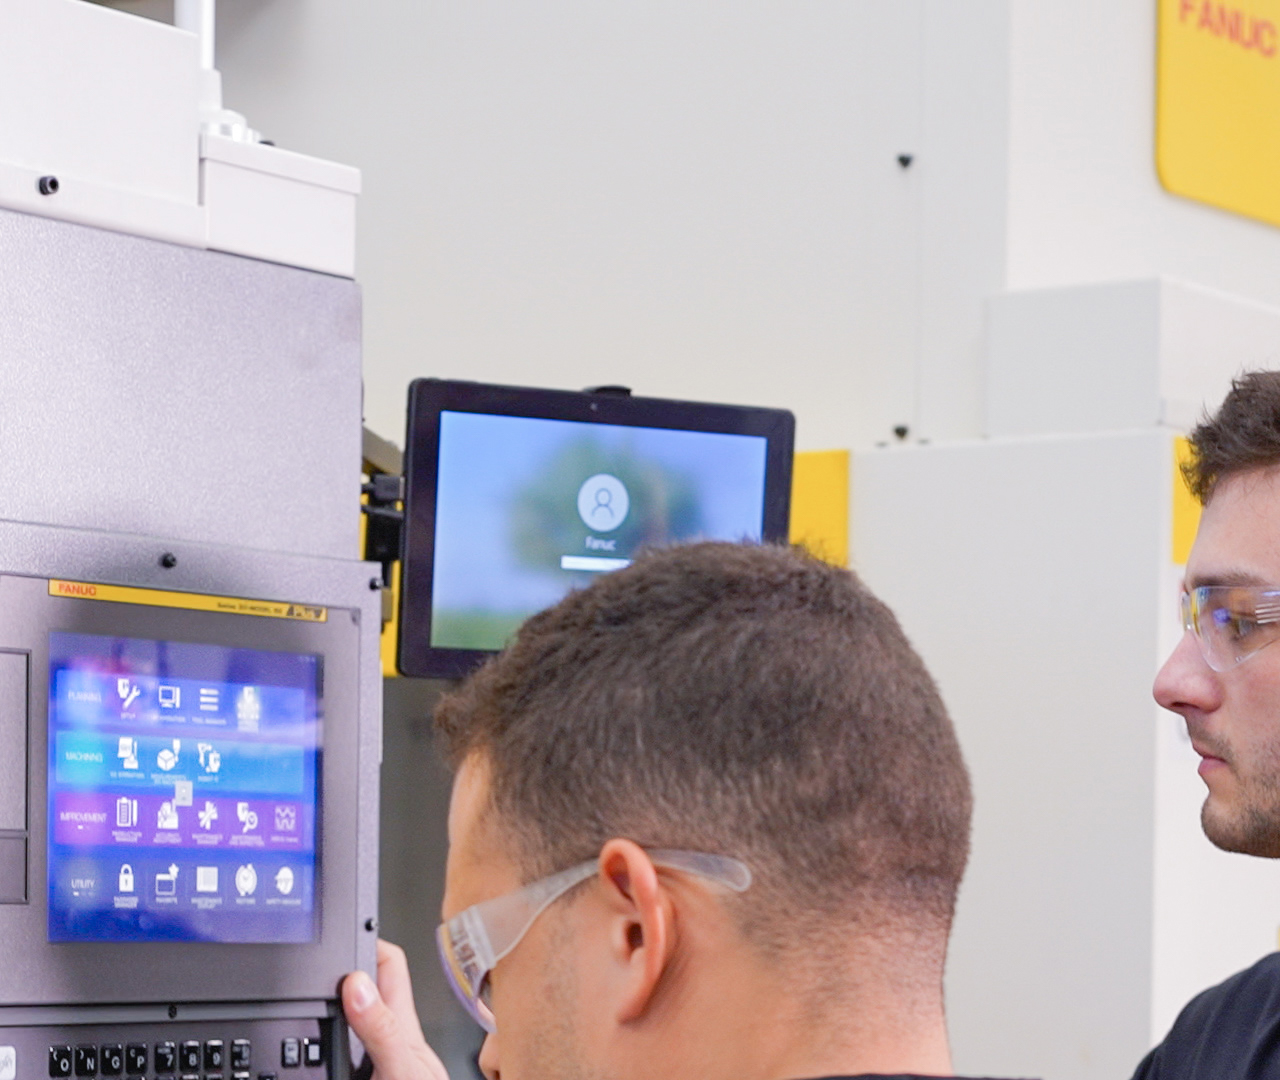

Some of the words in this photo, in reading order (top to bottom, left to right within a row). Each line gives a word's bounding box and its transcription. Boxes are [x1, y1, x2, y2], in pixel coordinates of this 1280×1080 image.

[1179, 0, 1278, 59] FANUC
[58, 583, 97, 597] FANUC
[86, 1057, 95, 1071] N
[111, 1056, 120, 1069] G
[137, 1055, 145, 1068] P
